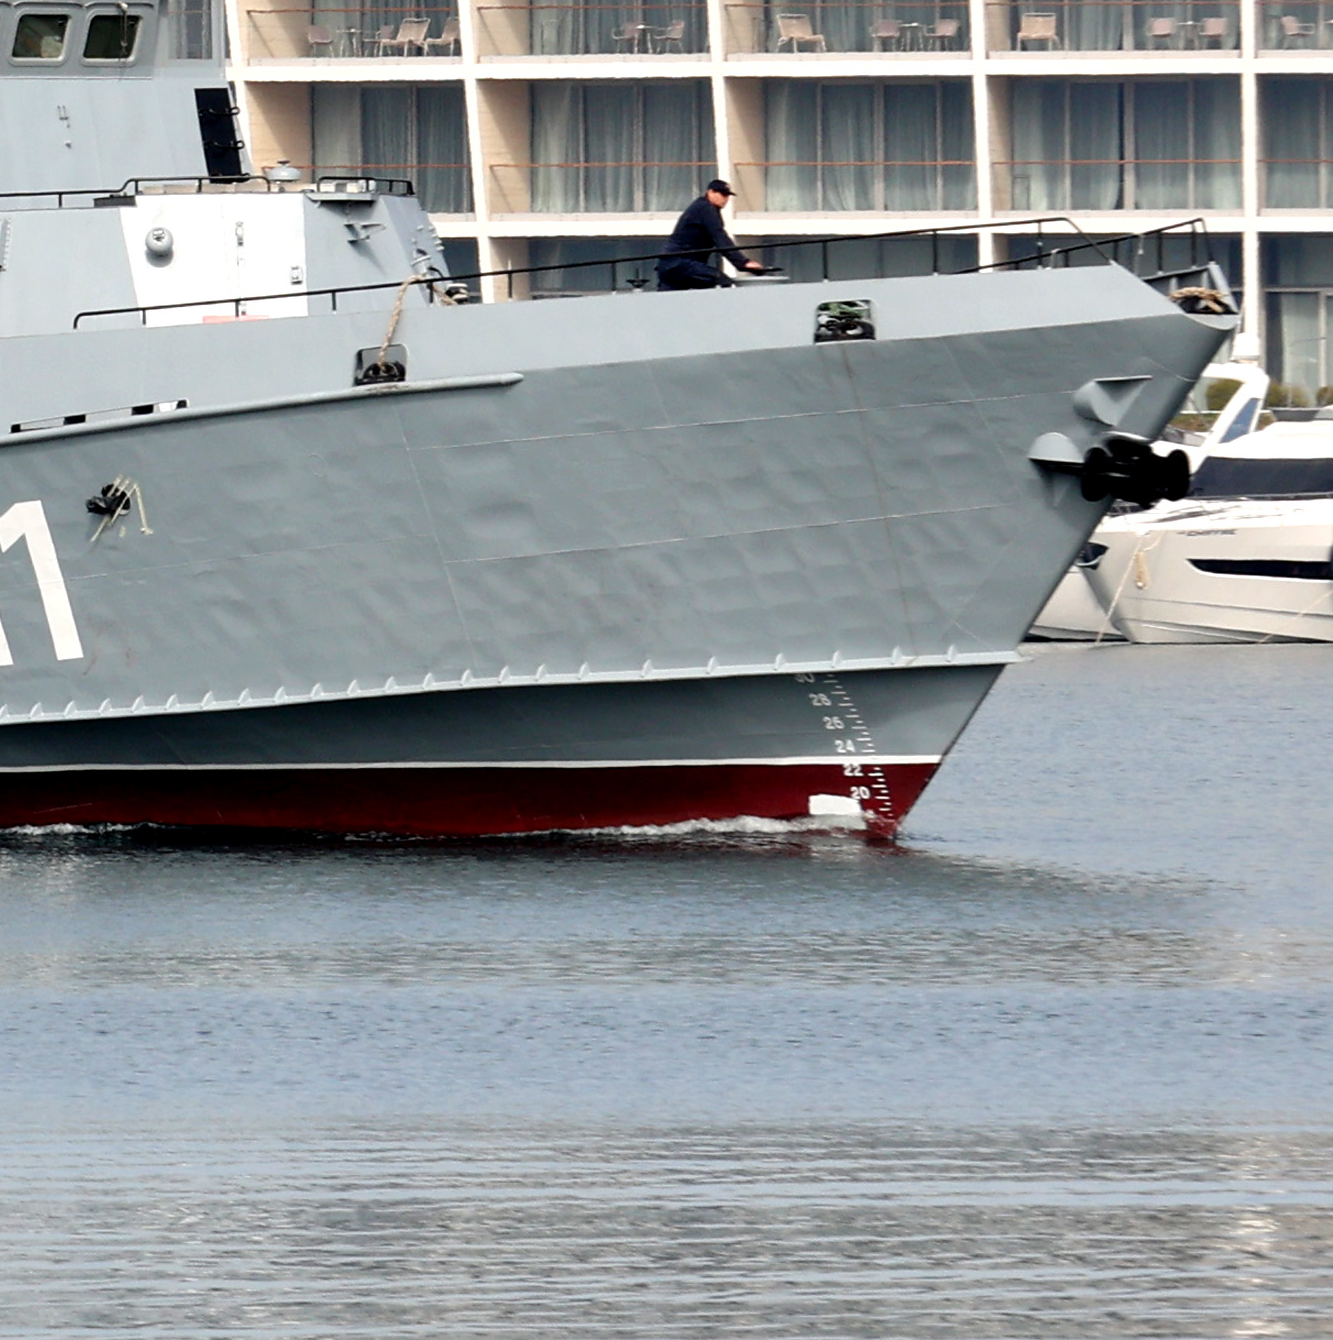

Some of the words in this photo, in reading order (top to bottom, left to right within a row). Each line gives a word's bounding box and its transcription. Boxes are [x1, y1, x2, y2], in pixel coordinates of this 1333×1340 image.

[808, 693, 832, 706] 28
[822, 716, 844, 730] 26
[834, 739, 855, 753] 24
[843, 763, 864, 776] 22
[850, 786, 870, 799] 20
